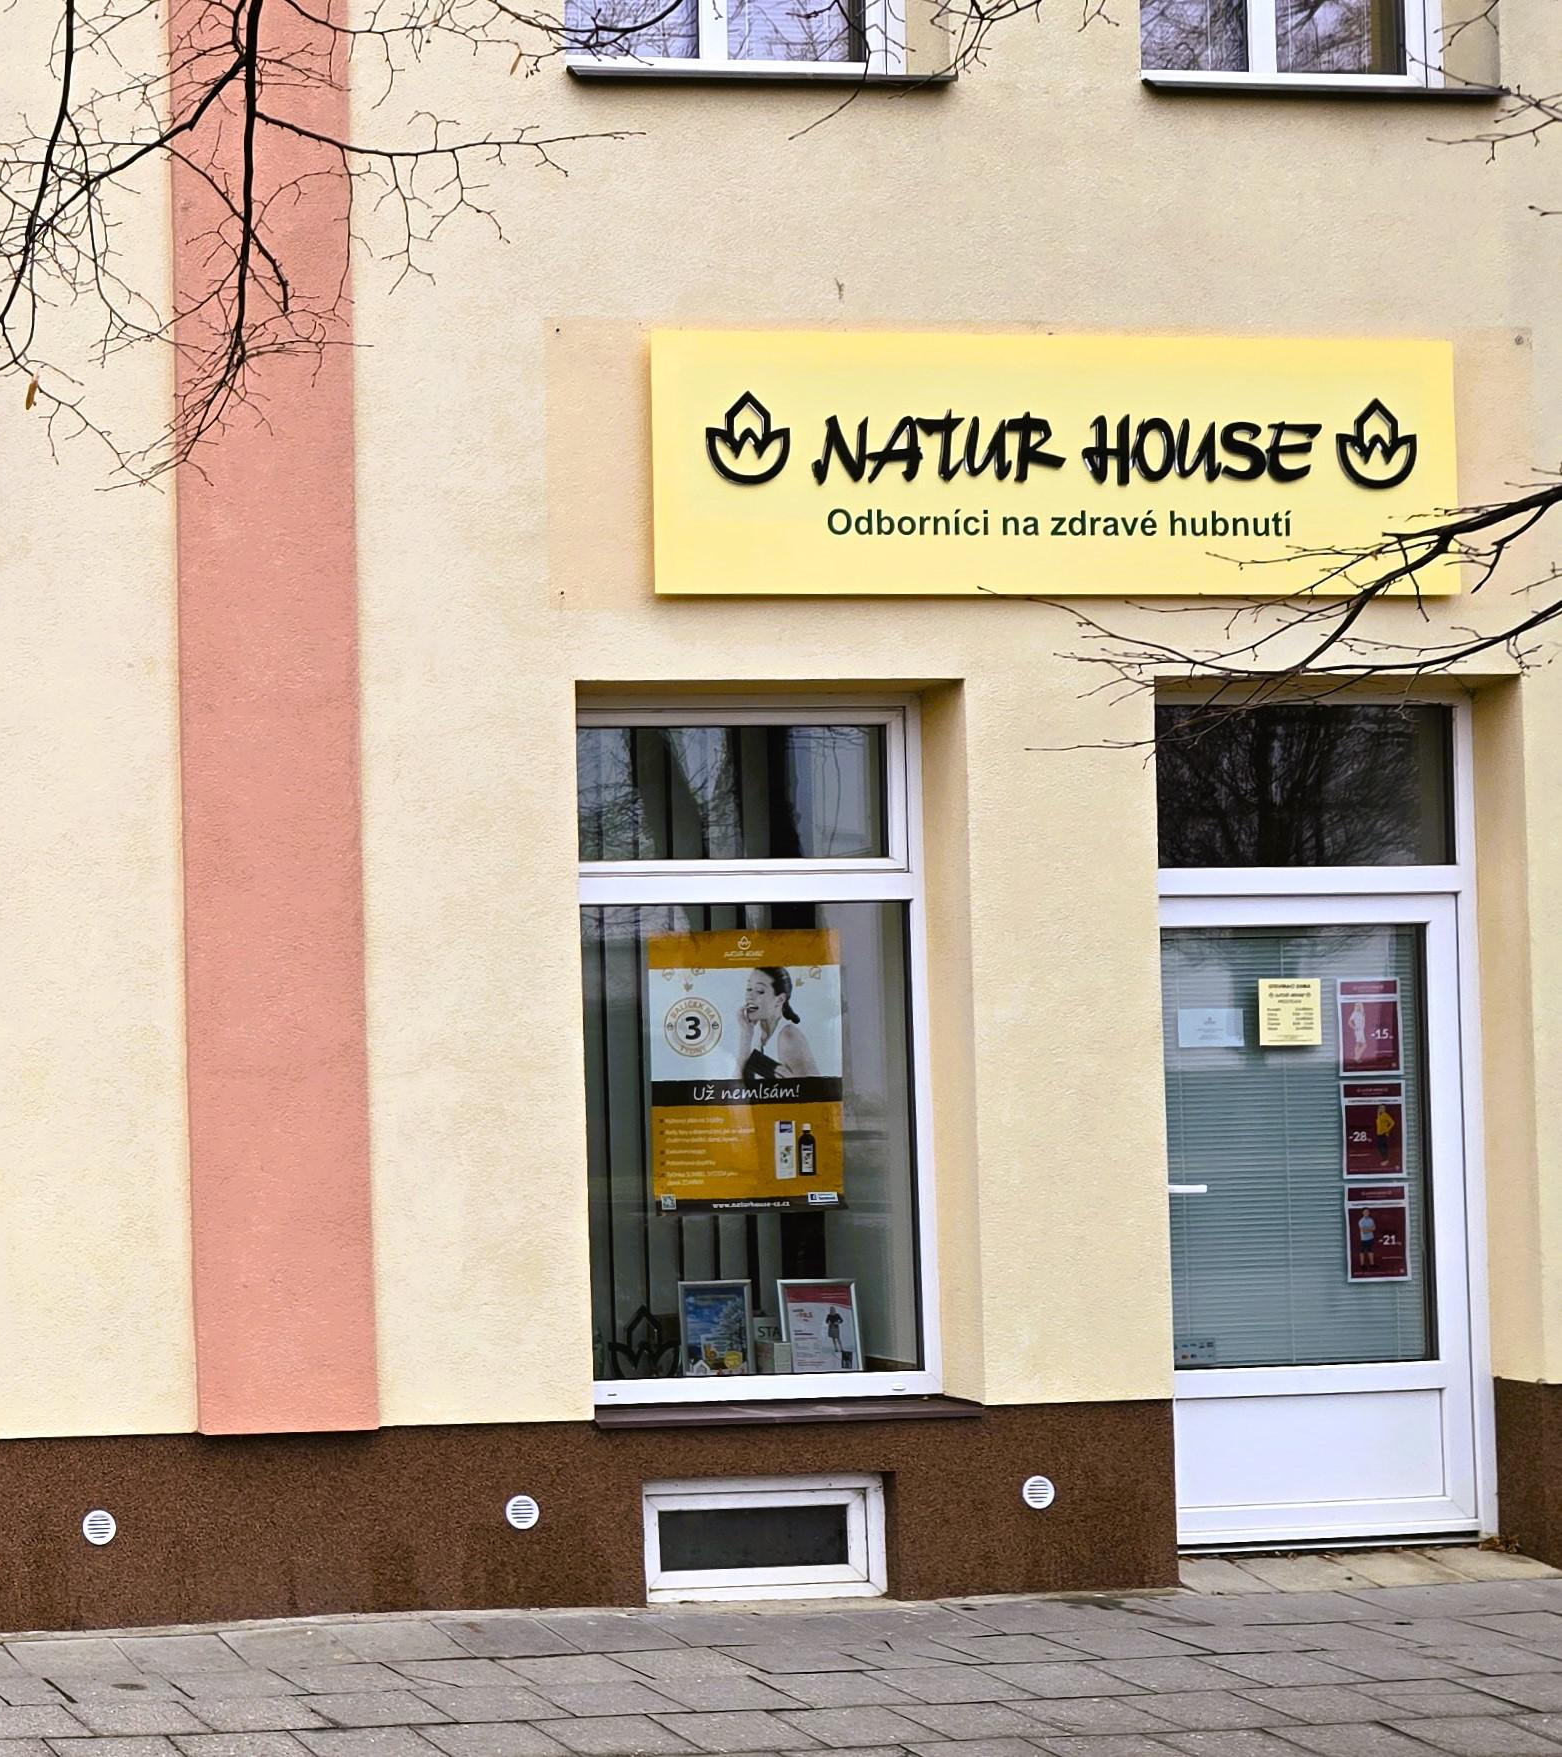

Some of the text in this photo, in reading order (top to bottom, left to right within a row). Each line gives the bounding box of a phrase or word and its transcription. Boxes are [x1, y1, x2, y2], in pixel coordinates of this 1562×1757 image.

[811, 410, 1323, 487] NATUR HOUSE
[827, 507, 1292, 538] Odborníci na zdravé hubnutí
[685, 1016, 702, 1040] 3
[693, 1082, 800, 1101] Už nemlsám!
